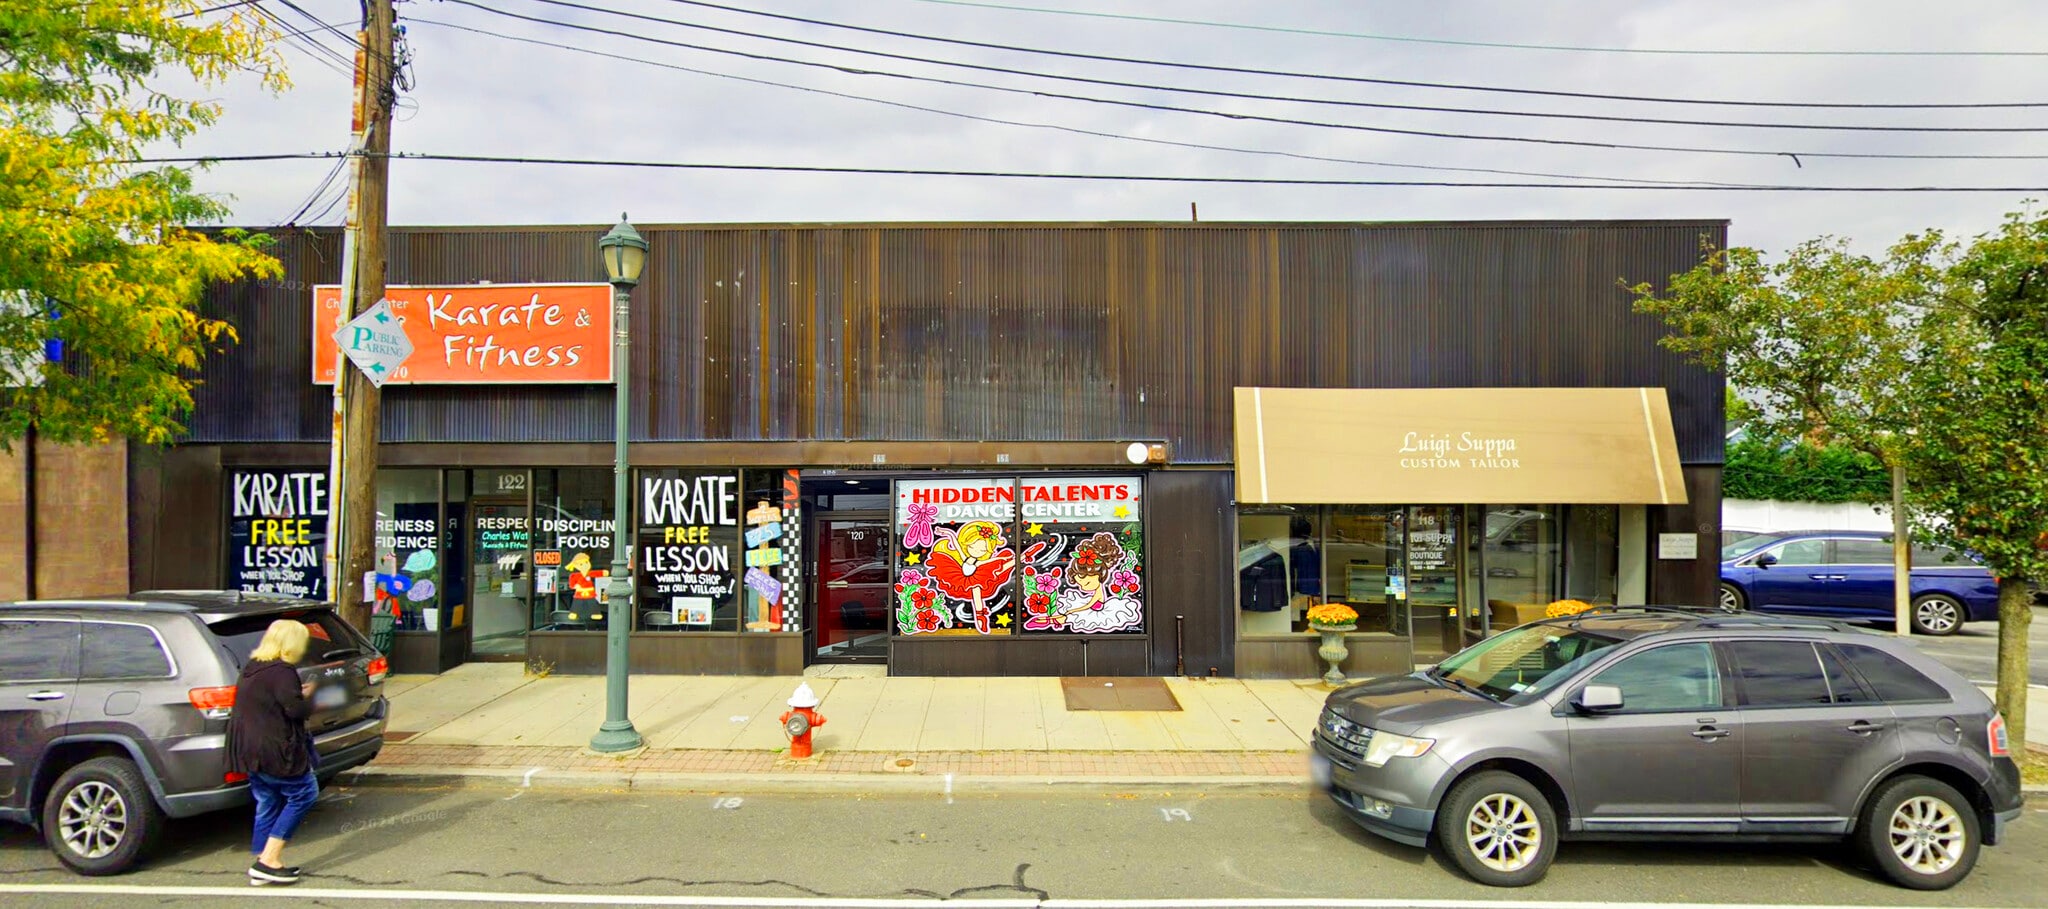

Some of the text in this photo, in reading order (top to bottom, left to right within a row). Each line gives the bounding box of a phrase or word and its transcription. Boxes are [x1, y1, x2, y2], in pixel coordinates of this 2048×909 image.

[426, 292, 591, 331] Karate &
[443, 335, 583, 373] Fitness
[1399, 431, 1516, 458] Luigi Suppa
[1400, 458, 1520, 469] CUSTOM TAILOR
[498, 474, 525, 490] 122
[233, 473, 328, 517] KARATE
[644, 476, 736, 526] KARATE
[912, 485, 1129, 504] HIDDEN TALENTS
[947, 503, 1102, 519] DANCE CENTER
[375, 520, 435, 532] RENESS
[543, 519, 616, 532] DISCIPLIN
[1418, 515, 1435, 526] 118
[251, 519, 311, 545] FREE
[512, 532, 528, 540] Wat
[664, 526, 710, 545] FREE
[851, 531, 864, 540] 120
[375, 536, 437, 549] FIDENCE
[558, 536, 610, 549] FOCUS
[244, 546, 317, 567] LESSON
[535, 551, 561, 565] CLOSED
[645, 545, 729, 572] LESSON
[1409, 551, 1443, 560] BOUTIQUE
[655, 573, 721, 585] WHEN YOU SHOP
[713, 797, 744, 809] 18
[1160, 807, 1192, 821] 19
